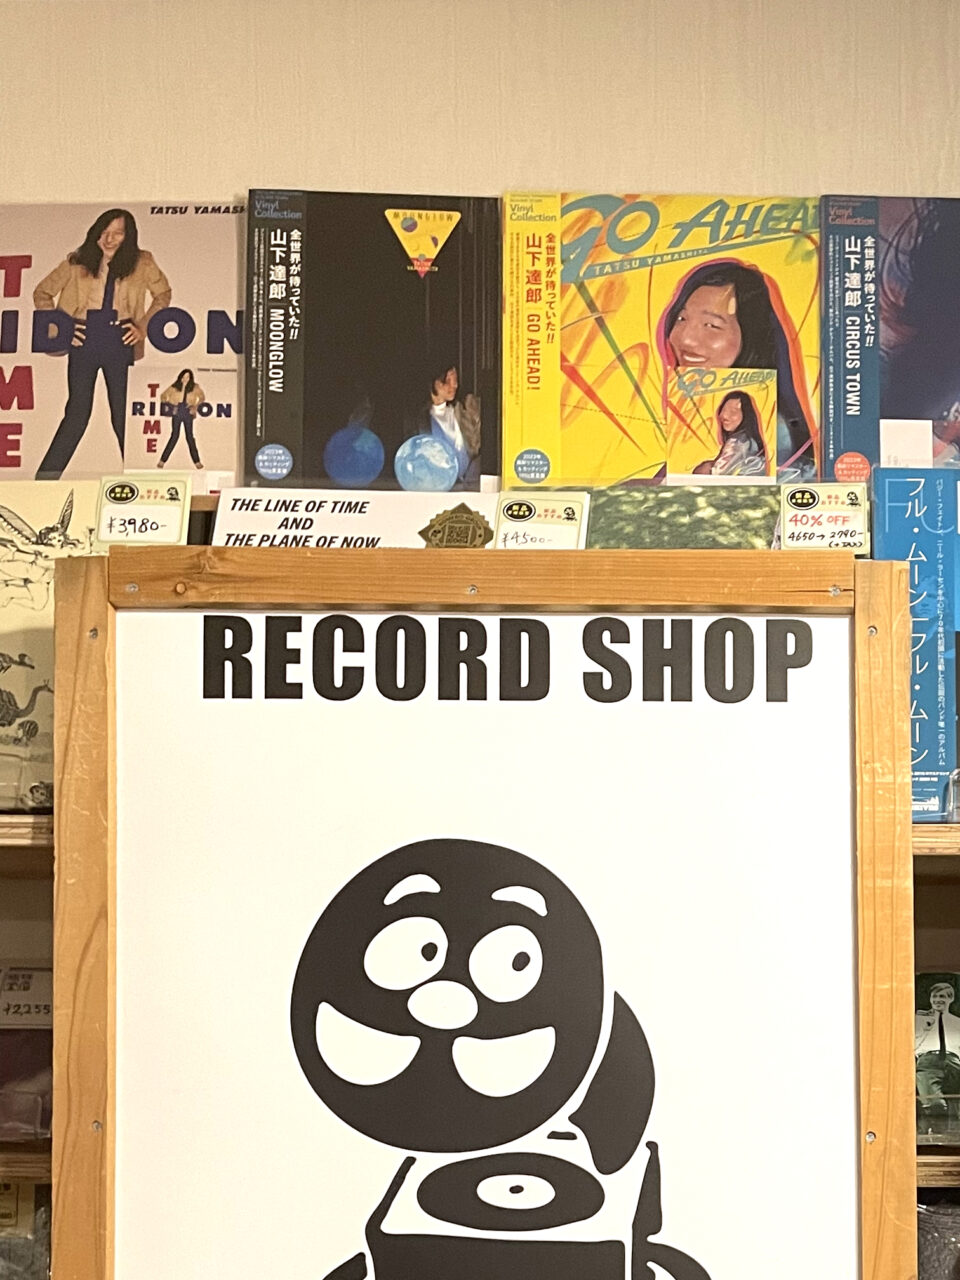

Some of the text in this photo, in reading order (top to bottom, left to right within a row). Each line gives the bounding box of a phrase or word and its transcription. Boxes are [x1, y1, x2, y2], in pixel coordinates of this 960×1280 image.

[150, 206, 187, 214] TATSU
[526, 233, 543, 303] 山下達郎
[594, 258, 640, 275] TATSU
[268, 228, 287, 392] 山下達郎 MOONGLOW
[527, 314, 541, 333] GO
[844, 235, 861, 416] 山下達郎 CIRCUS TOWN
[231, 498, 370, 514] THE LINE OF TIME
[277, 517, 314, 530] AND
[788, 514, 851, 527] 40% OFF
[225, 533, 256, 547] THE
[259, 534, 318, 548] PLANE
[321, 535, 341, 548] OF
[202, 614, 813, 703] RECORD SHOP
